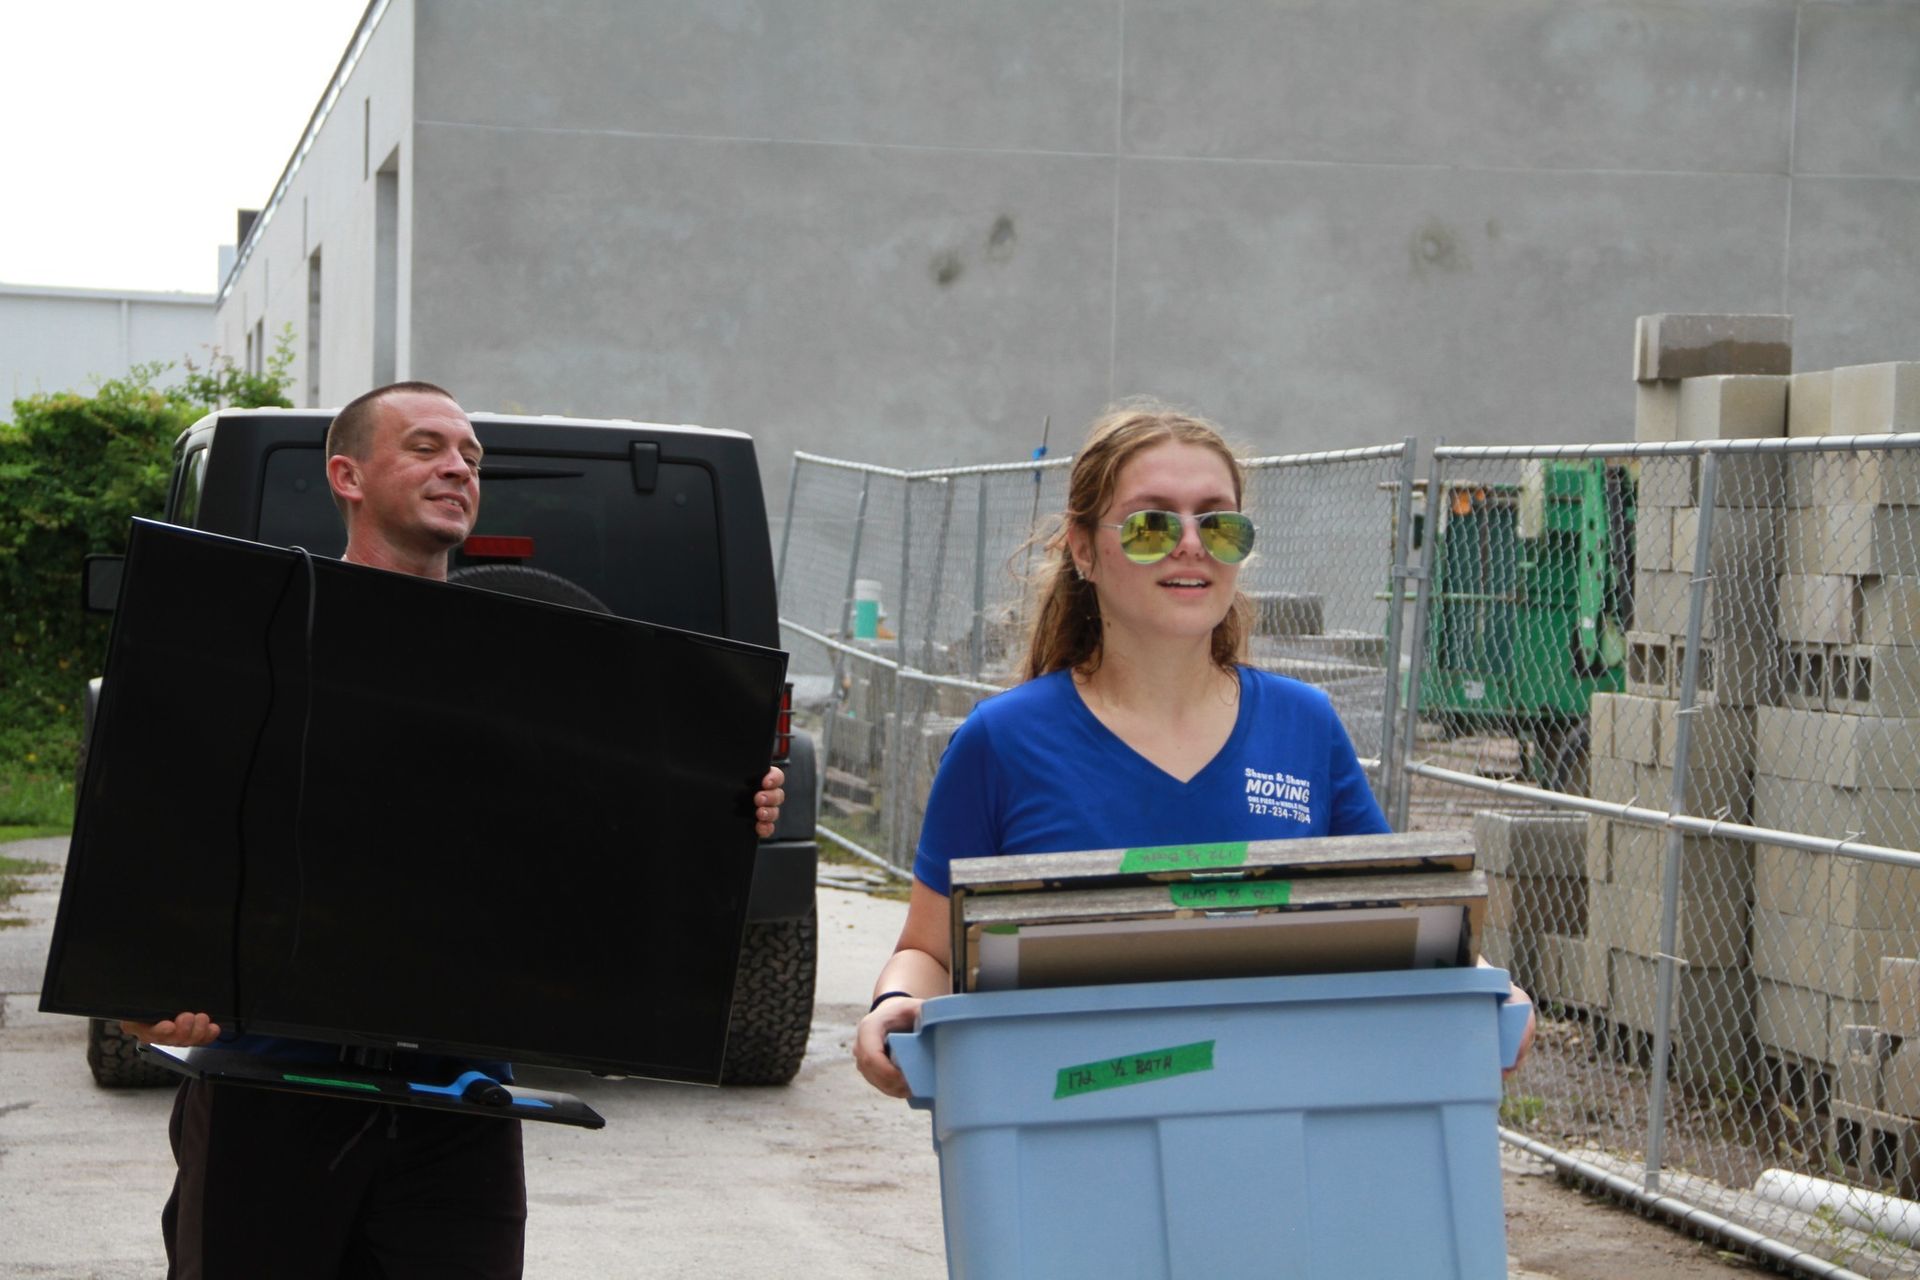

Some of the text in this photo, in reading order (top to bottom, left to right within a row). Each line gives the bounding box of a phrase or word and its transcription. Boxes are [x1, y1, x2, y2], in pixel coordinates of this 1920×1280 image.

[1276, 772, 1284, 782] &
[1245, 778, 1310, 804] MOVING
[1068, 1070, 1096, 1089] 172
[1135, 1054, 1173, 1076] BATH
